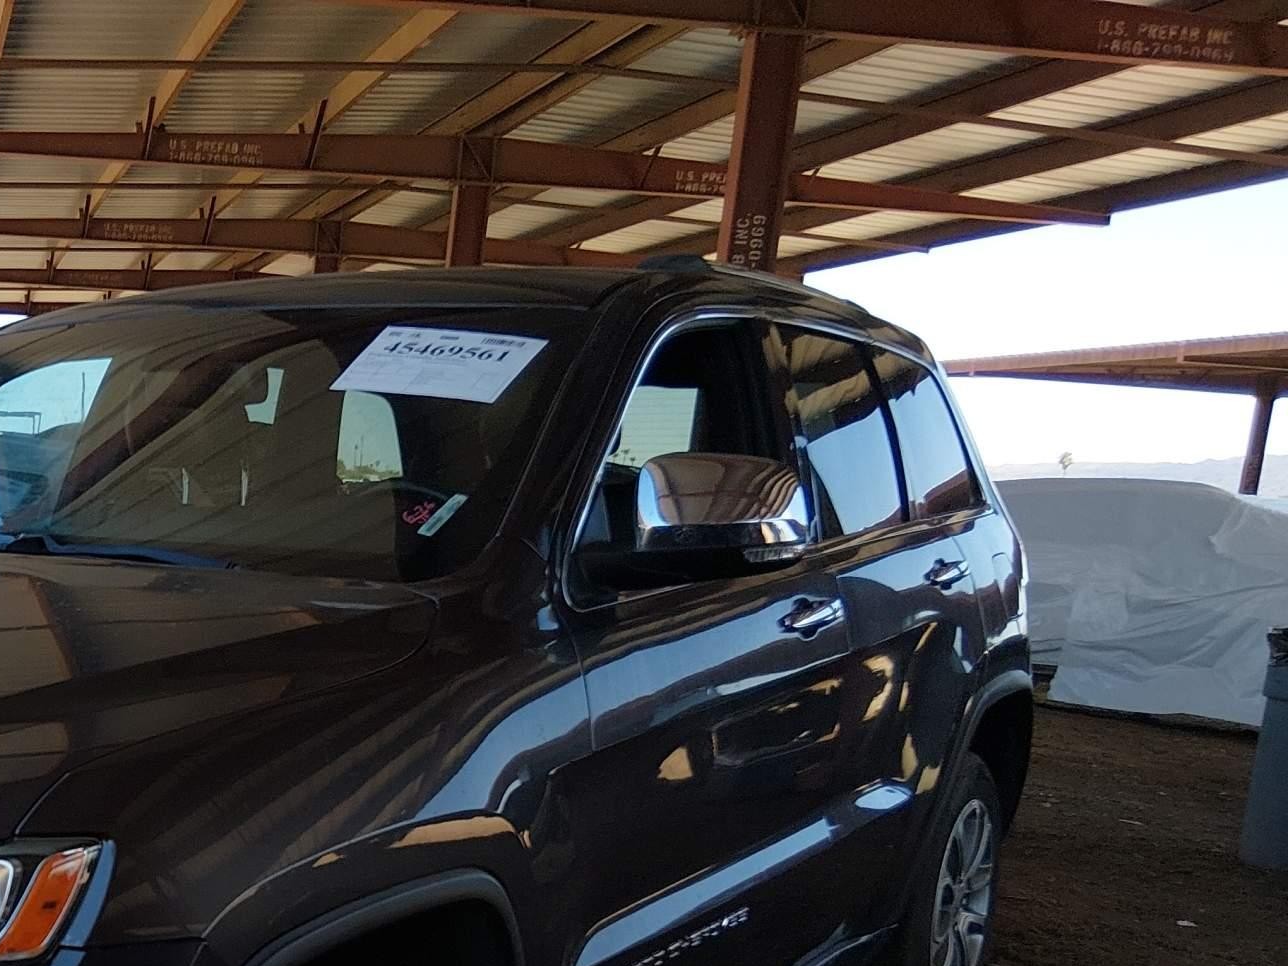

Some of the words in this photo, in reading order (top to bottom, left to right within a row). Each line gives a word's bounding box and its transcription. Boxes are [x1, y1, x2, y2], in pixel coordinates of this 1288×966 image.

[1097, 19, 1129, 37] U.S.
[1138, 23, 1202, 43] PREFAB
[383, 341, 511, 361] 45469561
